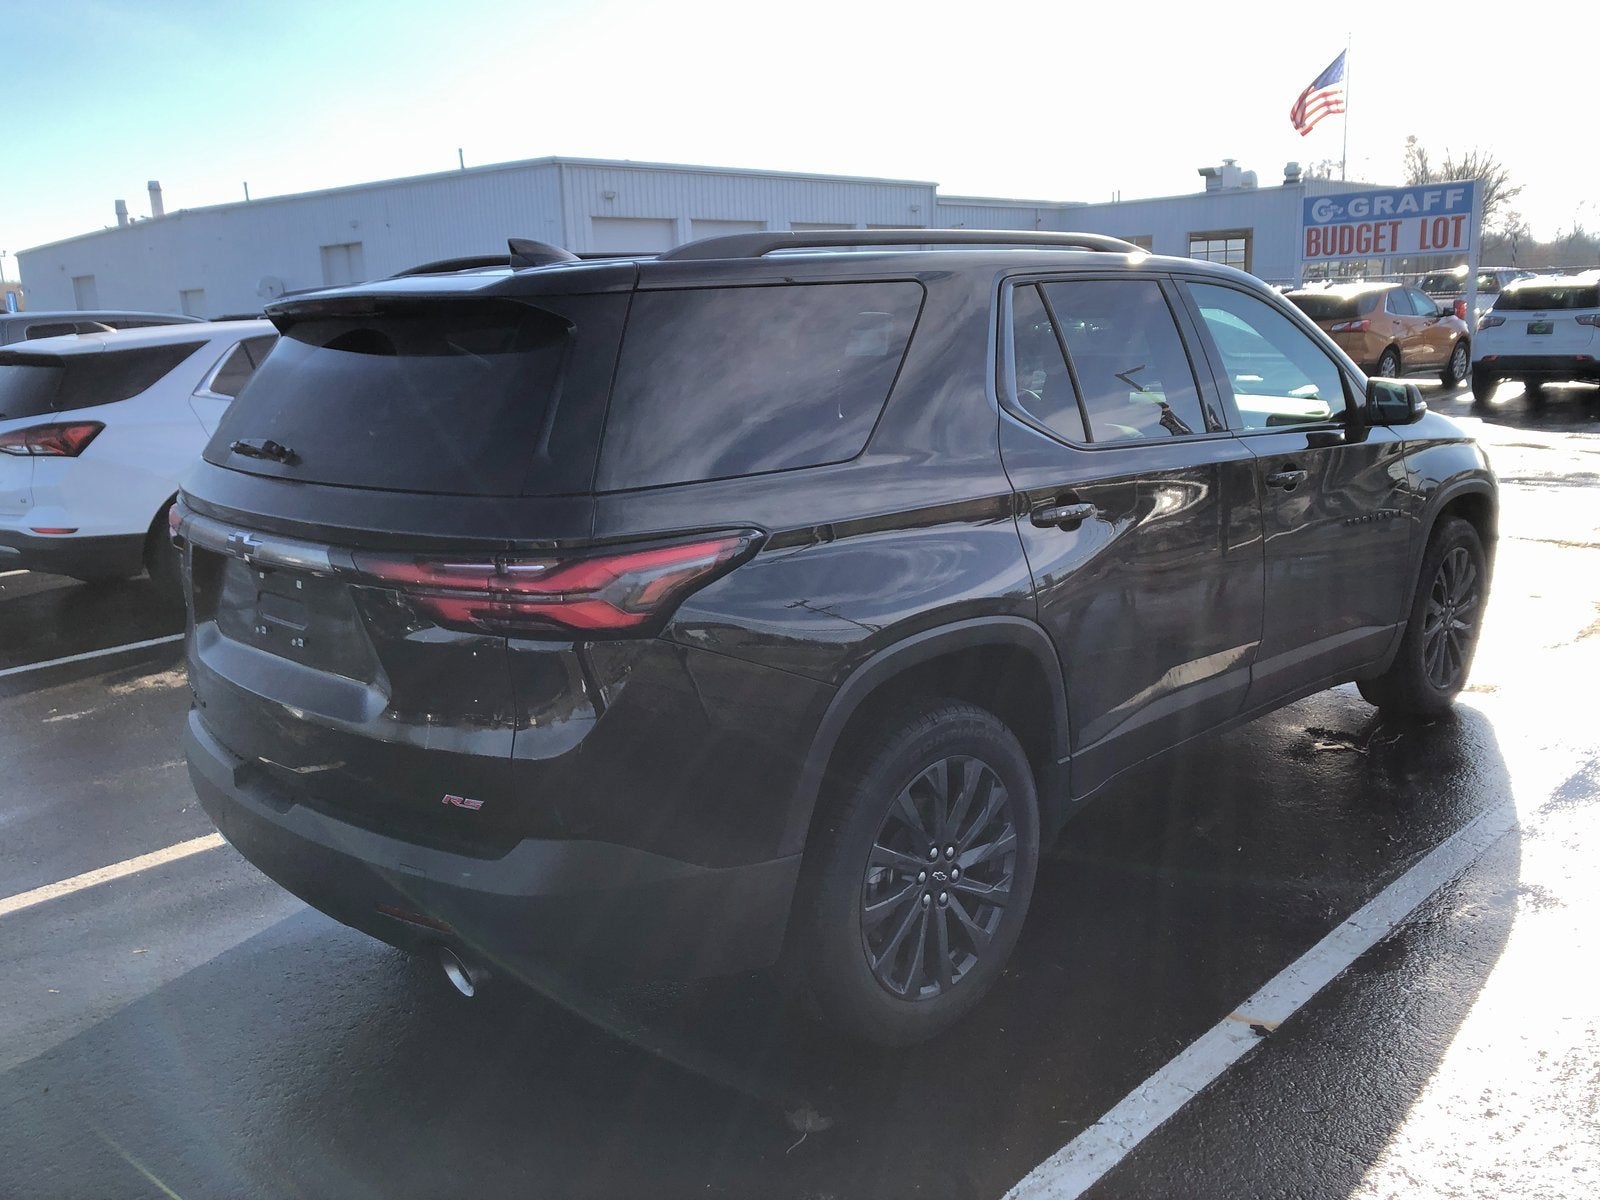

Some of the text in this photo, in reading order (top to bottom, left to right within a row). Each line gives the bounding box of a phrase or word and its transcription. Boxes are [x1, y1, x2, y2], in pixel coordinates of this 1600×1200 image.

[1348, 188, 1465, 217] GRAFF
[1306, 215, 1466, 257] BUDGET LOT
[442, 794, 484, 810] RS
